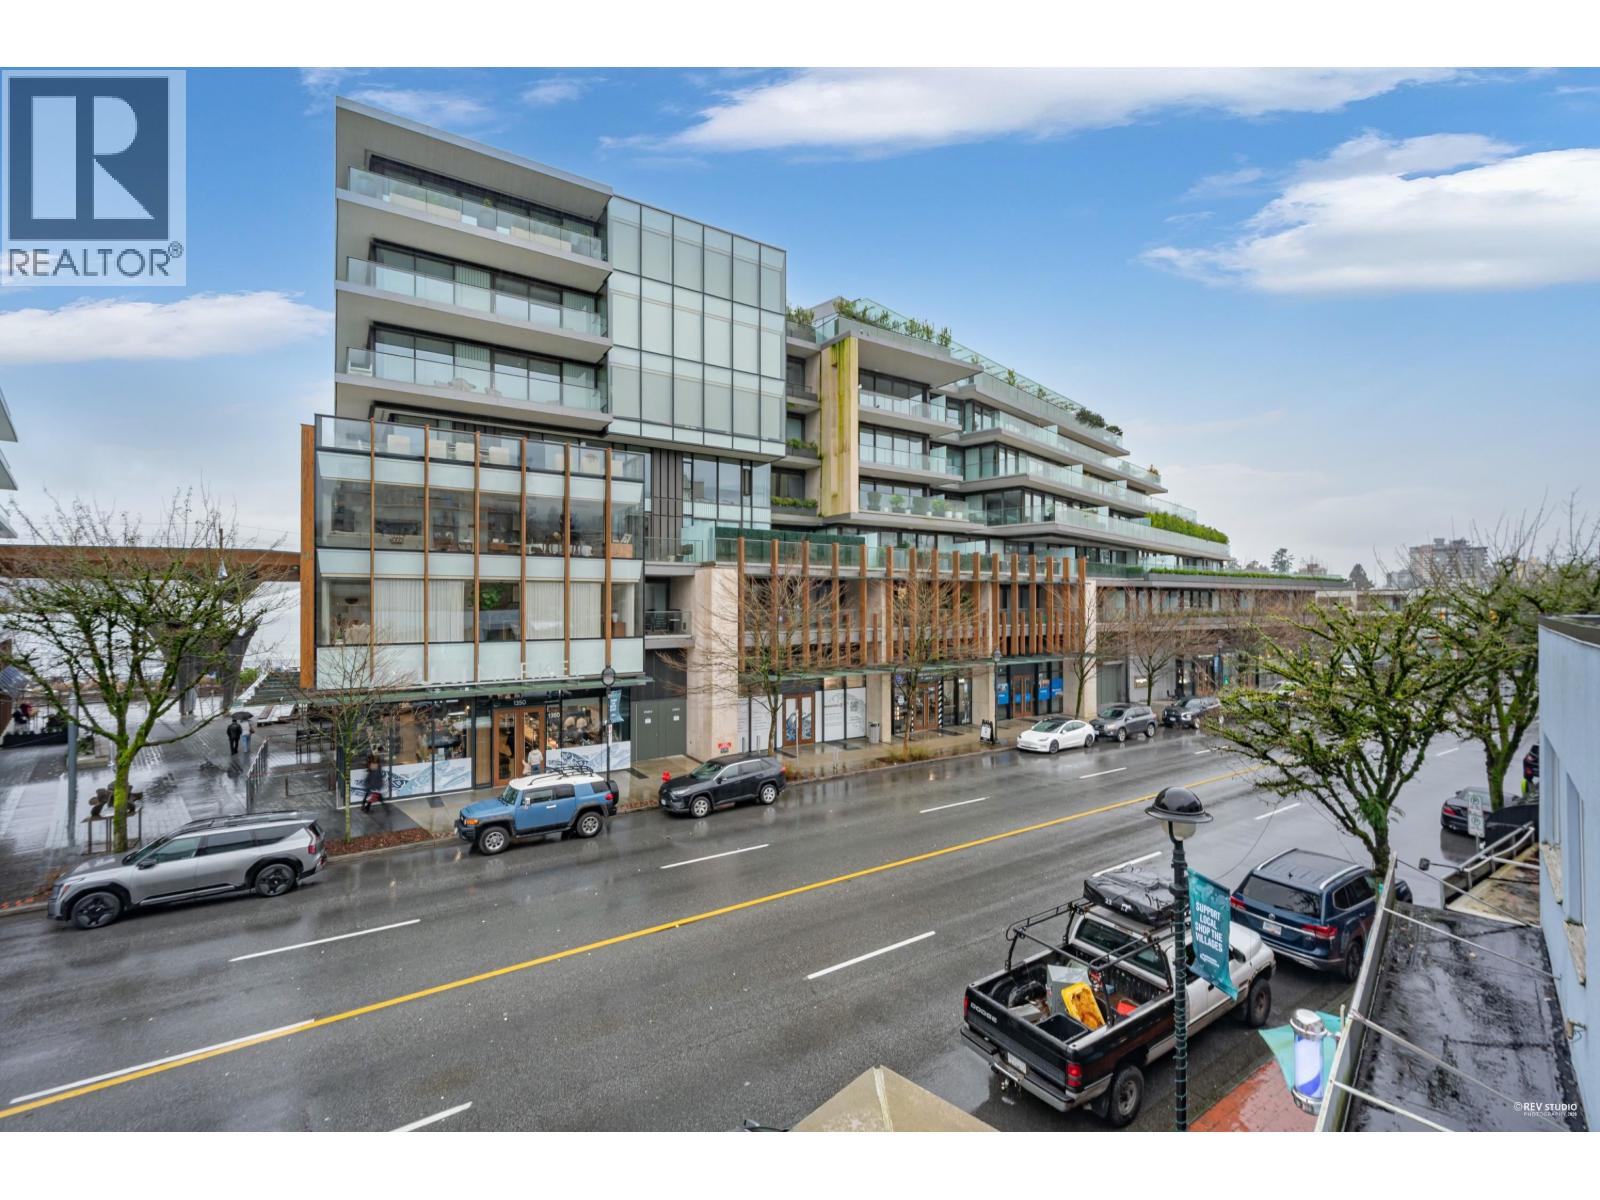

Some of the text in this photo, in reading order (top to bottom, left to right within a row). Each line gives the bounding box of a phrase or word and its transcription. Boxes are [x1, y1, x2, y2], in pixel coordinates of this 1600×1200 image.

[1195, 902, 1221, 920] SUPPORT
[1200, 914, 1217, 929] LOCAL
[1195, 921, 1223, 942] SHOP THE
[1195, 931, 1223, 952] VILLAGES
[970, 1002, 997, 1023] DODGE
